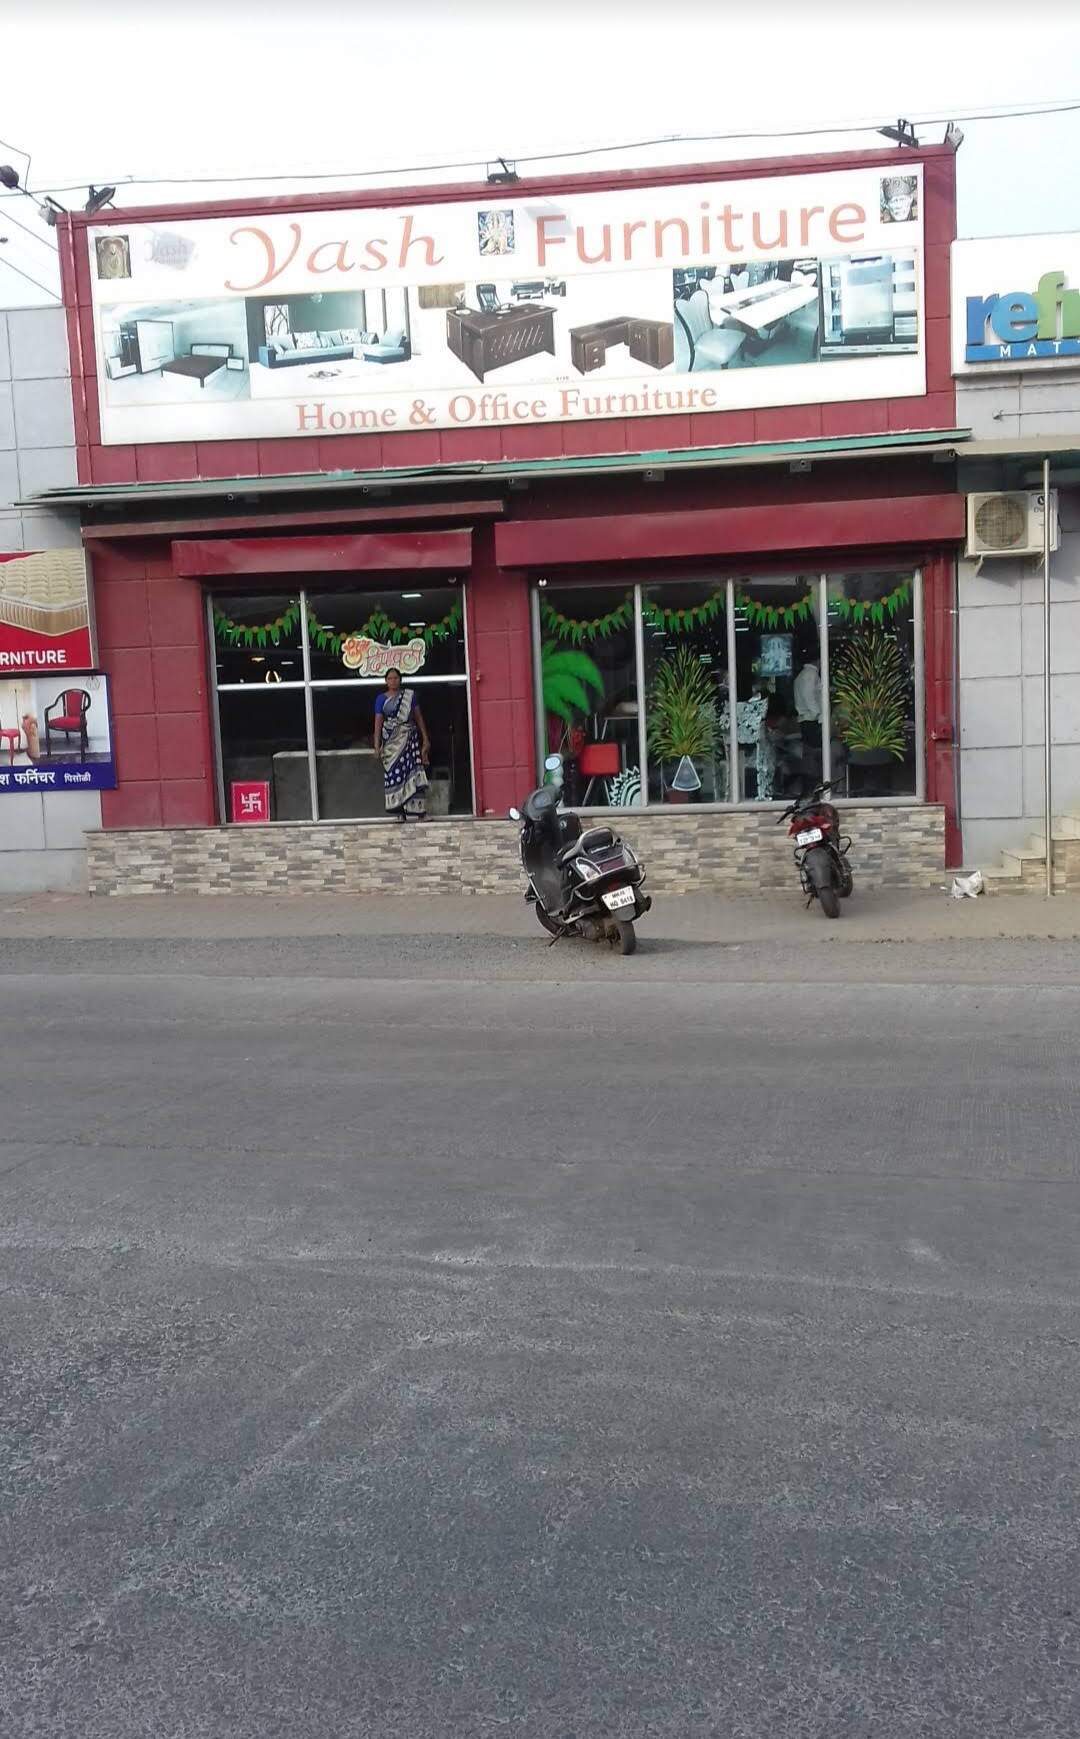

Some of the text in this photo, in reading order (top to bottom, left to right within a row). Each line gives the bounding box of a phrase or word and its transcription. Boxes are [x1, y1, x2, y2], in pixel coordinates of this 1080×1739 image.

[224, 202, 866, 291] Yash Furniture
[296, 384, 718, 431] Home & Office Furniture
[14, 768, 55, 785] फर्निचर
